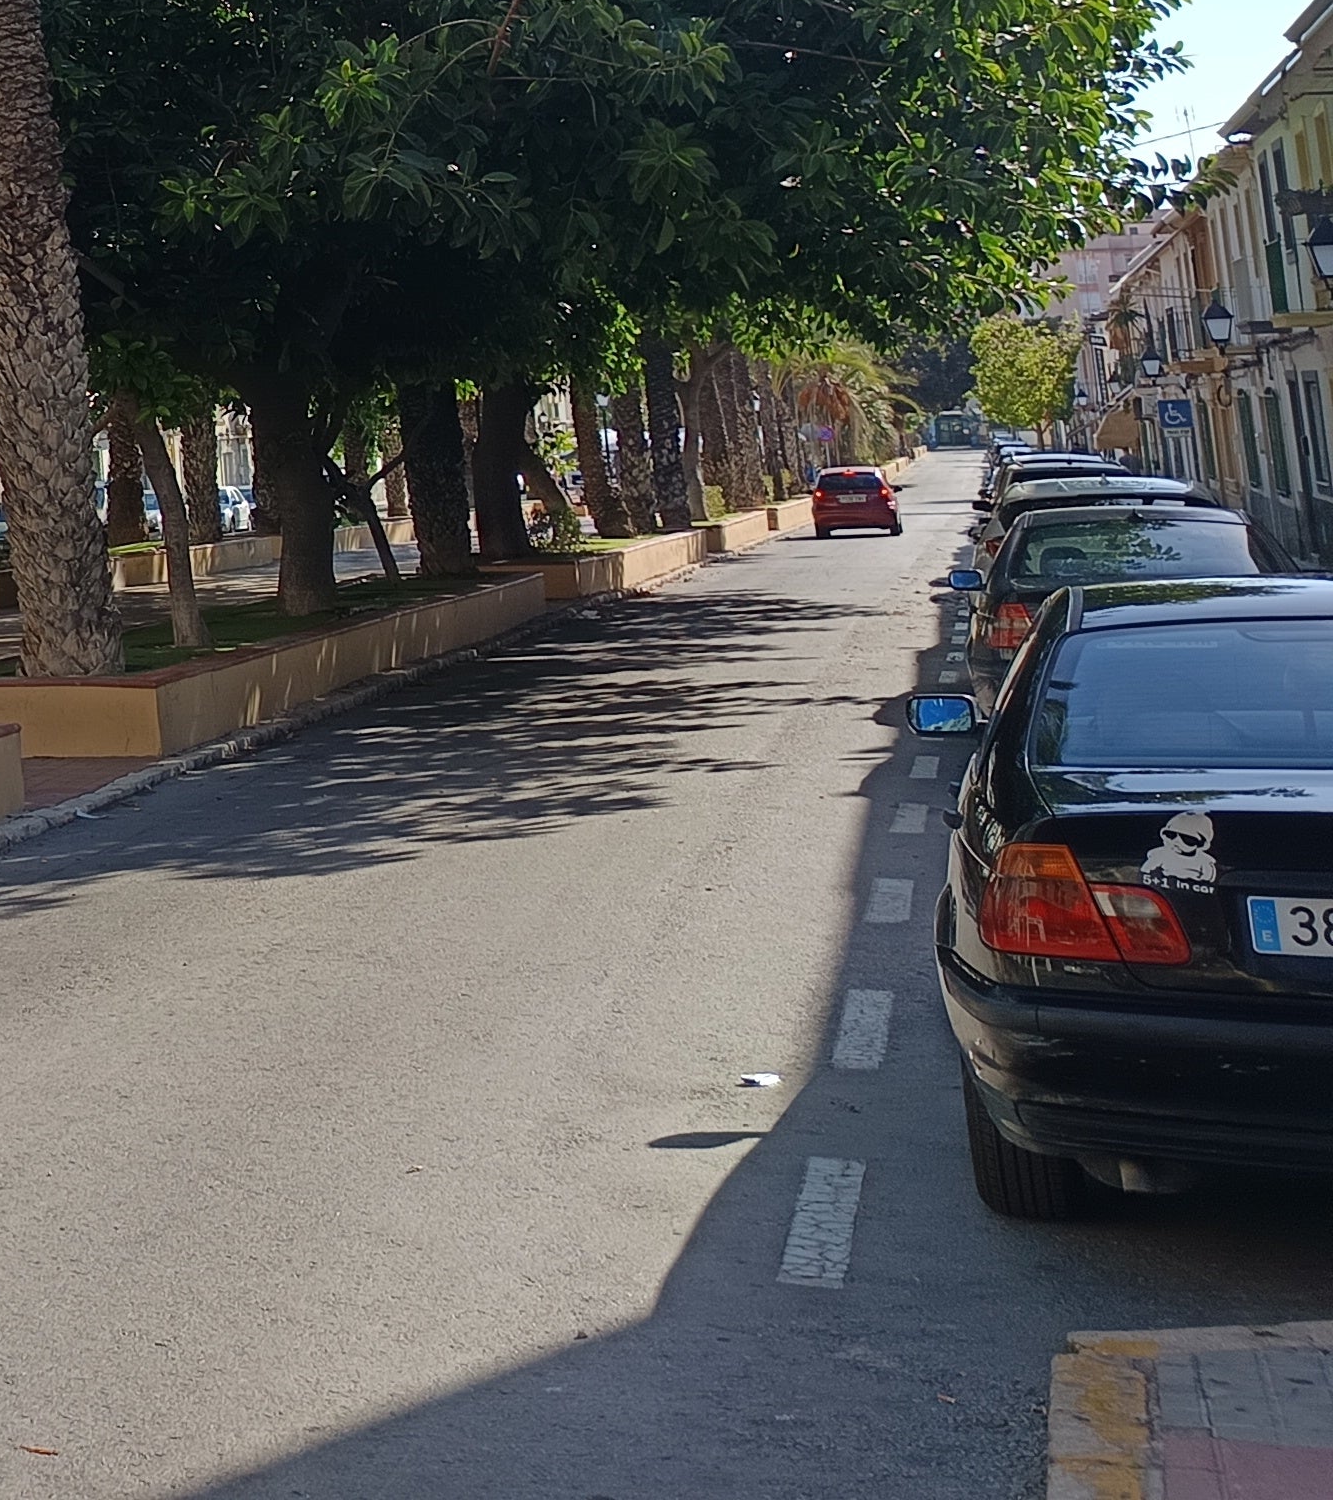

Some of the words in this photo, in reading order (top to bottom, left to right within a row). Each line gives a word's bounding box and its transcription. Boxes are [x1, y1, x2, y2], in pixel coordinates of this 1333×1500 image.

[1142, 874, 1170, 888] 5+1
[1193, 884, 1214, 894] car
[1262, 930, 1273, 942] E
